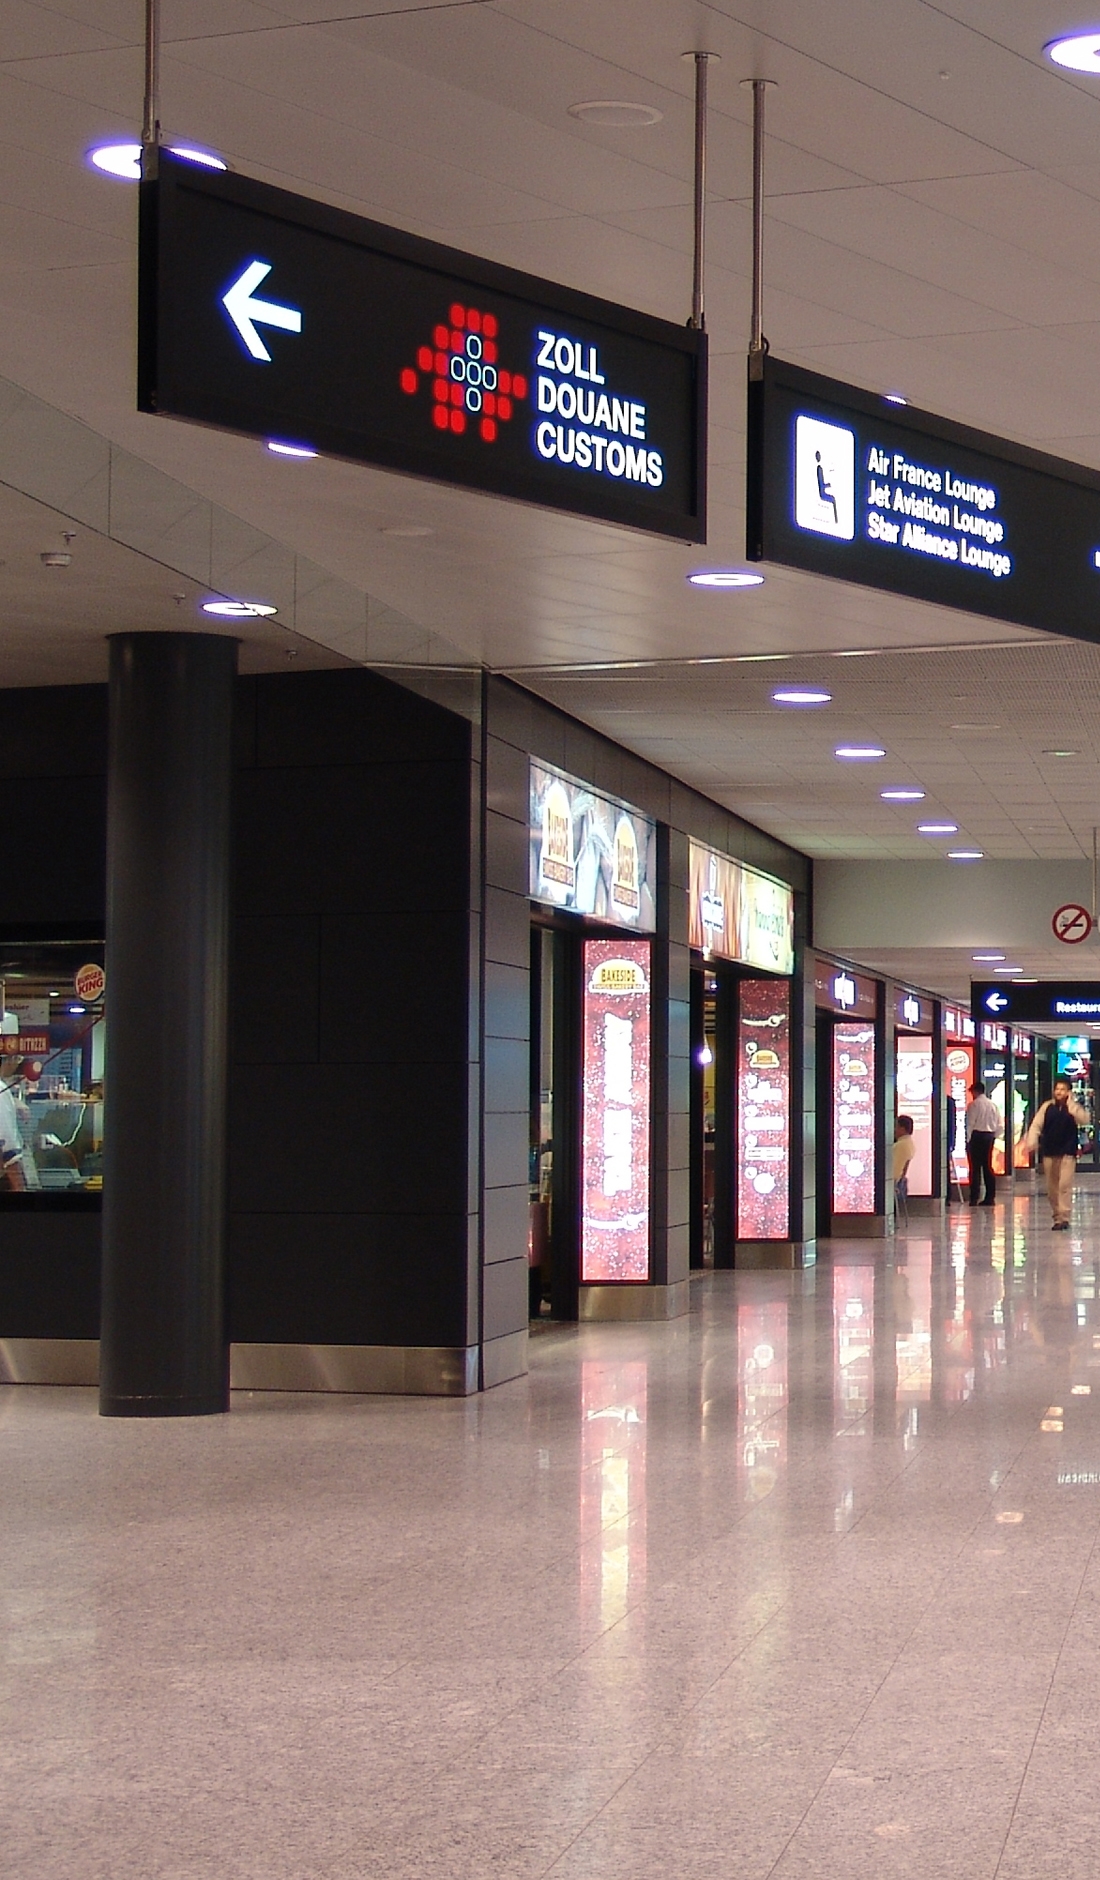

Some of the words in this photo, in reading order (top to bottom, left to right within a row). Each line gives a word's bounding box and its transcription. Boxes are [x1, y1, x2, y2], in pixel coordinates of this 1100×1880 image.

[537, 330, 605, 385] ZOLL
[537, 375, 646, 440] DOUANE
[537, 421, 663, 487] CUSTOMS
[867, 446, 891, 476] Air
[893, 454, 942, 493] France
[945, 470, 996, 511] Lounge
[867, 479, 891, 510] Jet
[892, 486, 950, 527] Aviation
[953, 504, 1004, 545] Lounge
[867, 511, 901, 544] Star
[901, 521, 959, 561] Alliance
[960, 537, 1011, 577] Lounge
[78, 978, 104, 996] KING
[601, 968, 636, 982] BAKESIDE
